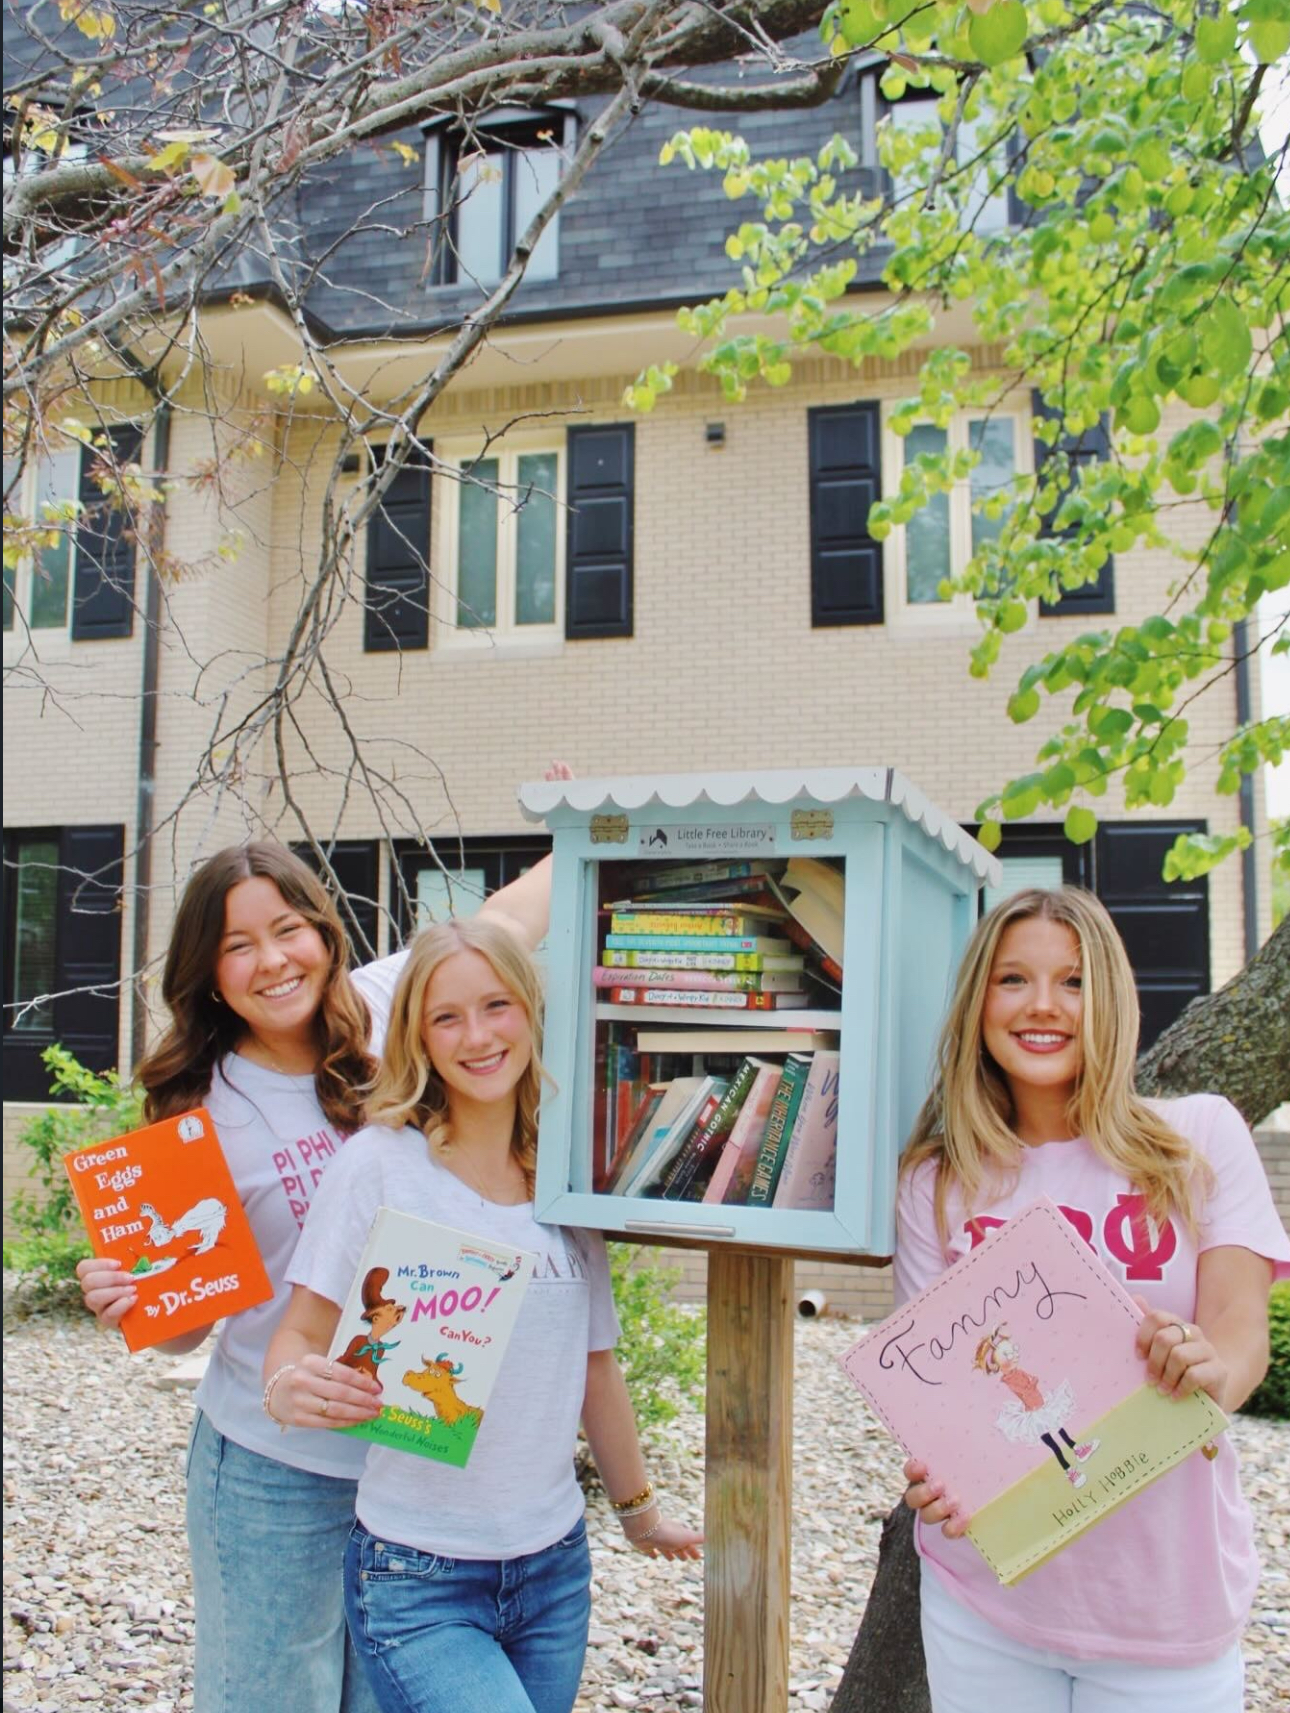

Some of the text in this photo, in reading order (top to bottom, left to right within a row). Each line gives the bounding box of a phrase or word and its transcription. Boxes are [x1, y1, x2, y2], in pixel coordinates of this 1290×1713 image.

[677, 827, 767, 842] Little Free Library
[601, 971, 646, 985] Expiration
[648, 971, 676, 983] Dates
[720, 1063, 750, 1112] MEXICAN
[777, 1080, 795, 1101] THE
[697, 1114, 722, 1151] GOTHIC
[760, 1101, 789, 1165] INHERITANCE
[73, 1145, 128, 1173] Green
[272, 1148, 297, 1174] PI
[296, 1130, 336, 1165] PHI
[95, 1163, 143, 1192] Eggs
[281, 1174, 307, 1197] PI
[751, 1162, 774, 1201] GAMES
[93, 1196, 130, 1221] and
[100, 1218, 144, 1243] Ham
[397, 1266, 417, 1279] Mr.
[418, 1263, 460, 1280] Brown
[144, 1273, 240, 1318] By Dr. Seuss
[410, 1280, 435, 1293] Can
[410, 1286, 501, 1323] MOO!
[879, 1261, 1087, 1386] Fanny
[388, 1406, 432, 1435] Seuss's
[371, 1422, 416, 1441] Wonderful
[417, 1436, 450, 1453] Noises
